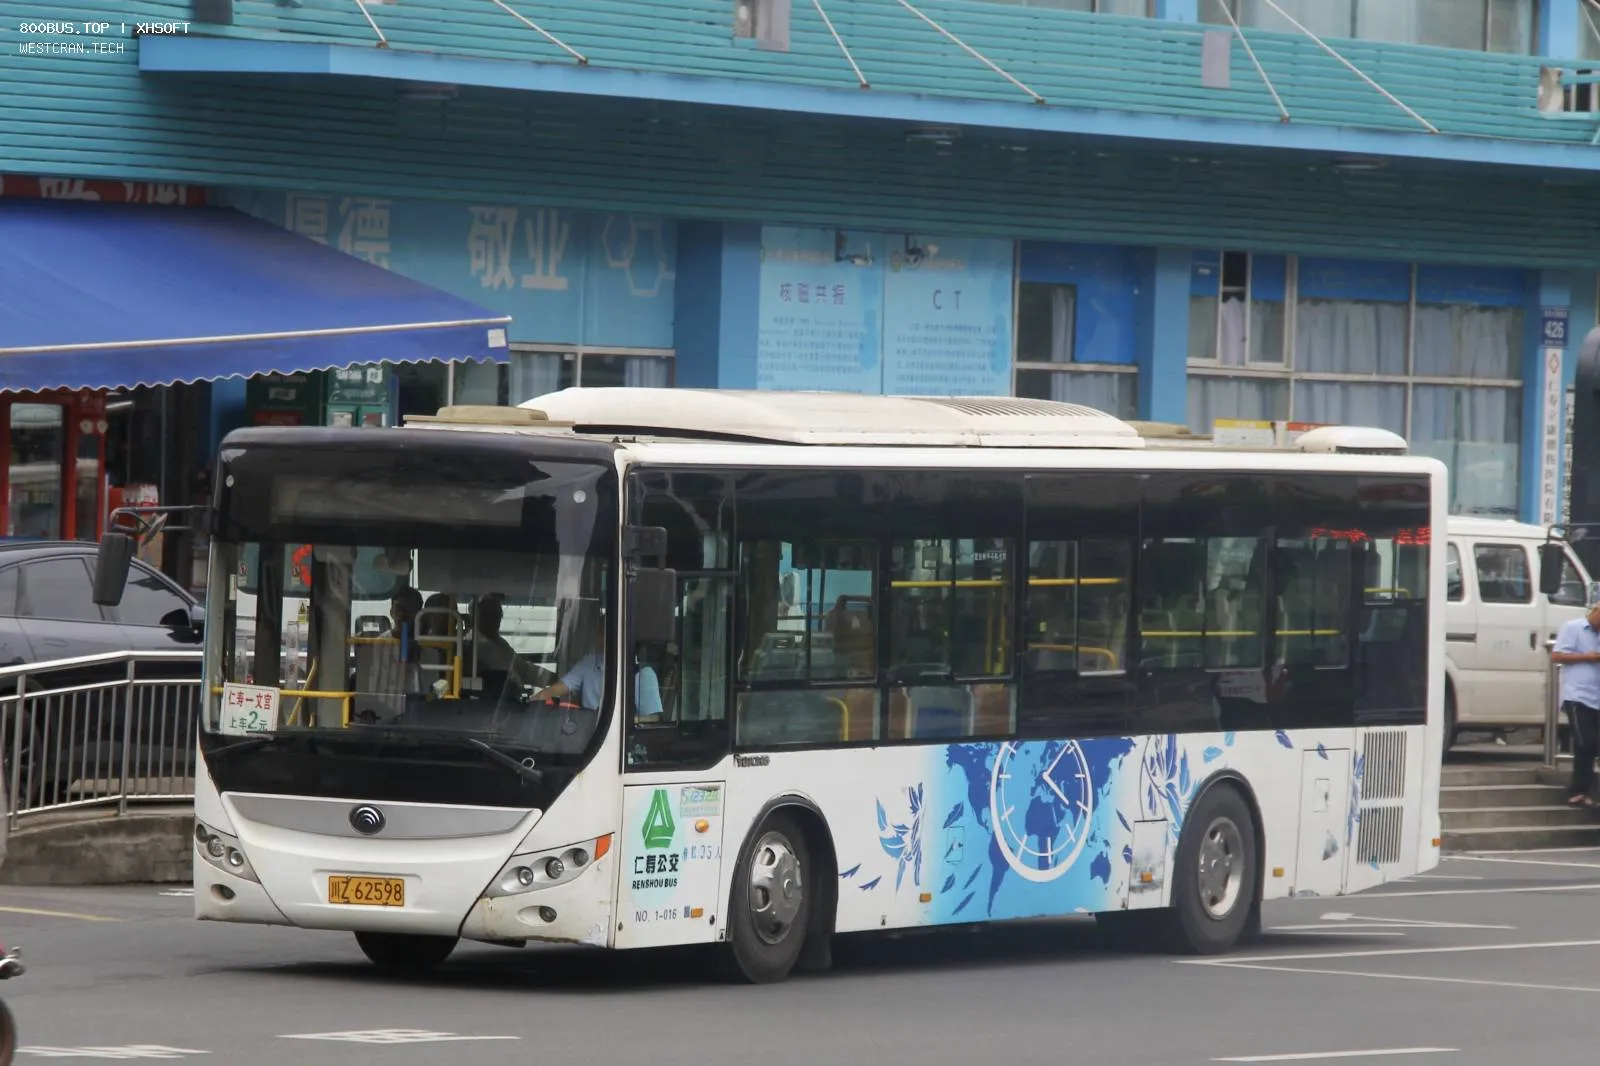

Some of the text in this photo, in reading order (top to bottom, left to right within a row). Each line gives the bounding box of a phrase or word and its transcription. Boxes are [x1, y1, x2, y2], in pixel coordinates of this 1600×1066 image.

[468, 206, 569, 290] 敬业
[634, 853, 679, 874] 仁寿公交
[632, 877, 678, 890] RENSHOU BUS
[655, 908, 677, 921] 1-016
